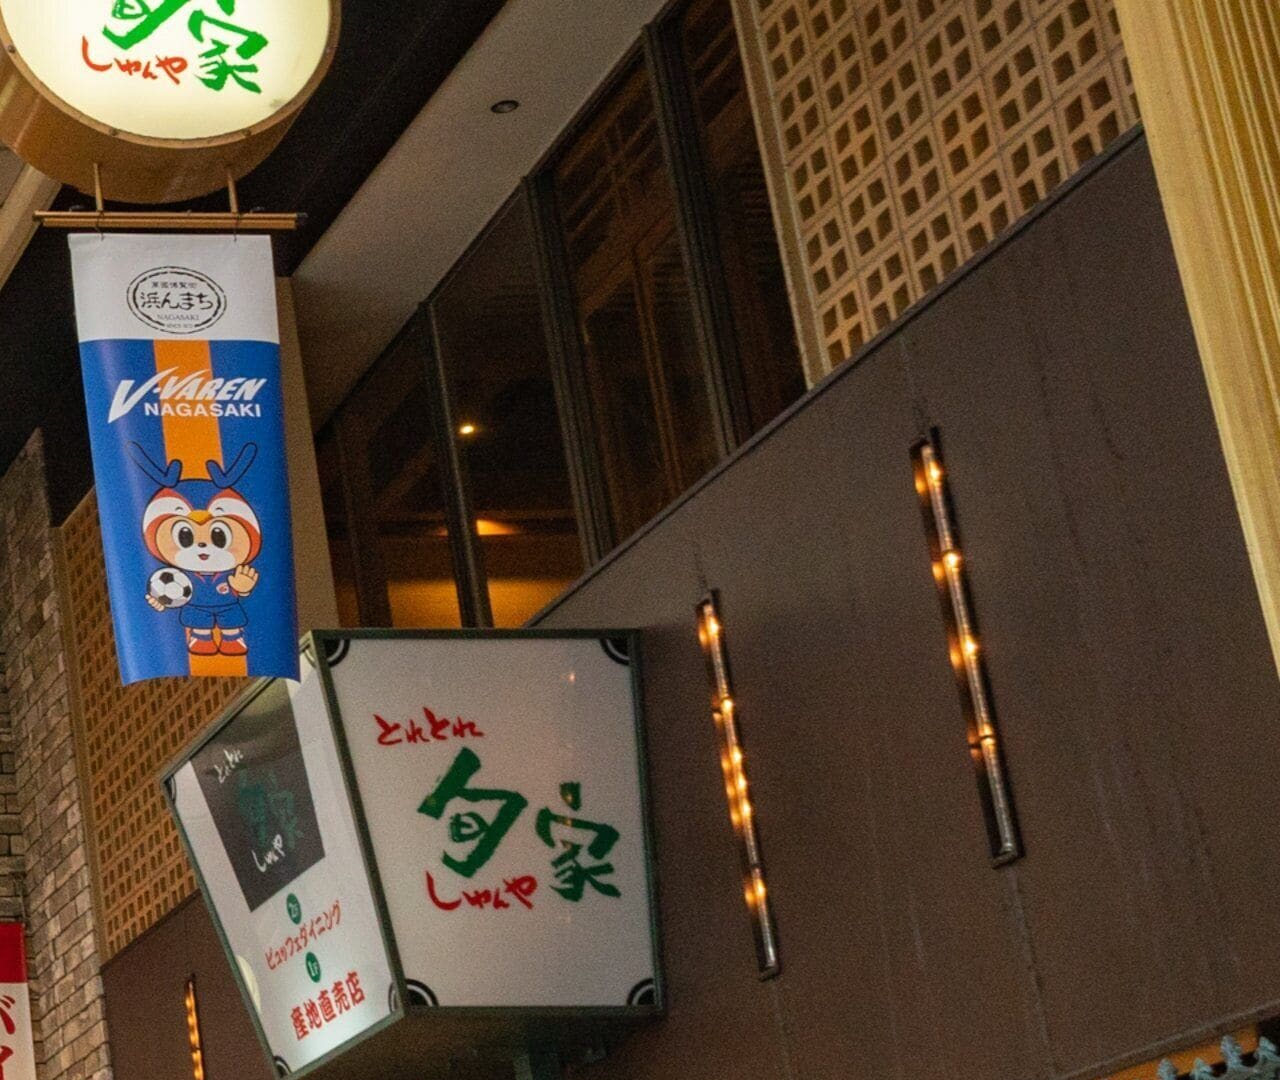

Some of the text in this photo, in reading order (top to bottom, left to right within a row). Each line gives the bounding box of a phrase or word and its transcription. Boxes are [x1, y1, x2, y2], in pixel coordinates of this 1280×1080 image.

[108, 366, 268, 423] V-VAREN
[144, 402, 261, 418] NAGASAKI
[416, 746, 623, 903] 旬家
[290, 969, 366, 1042] 産地直売店
